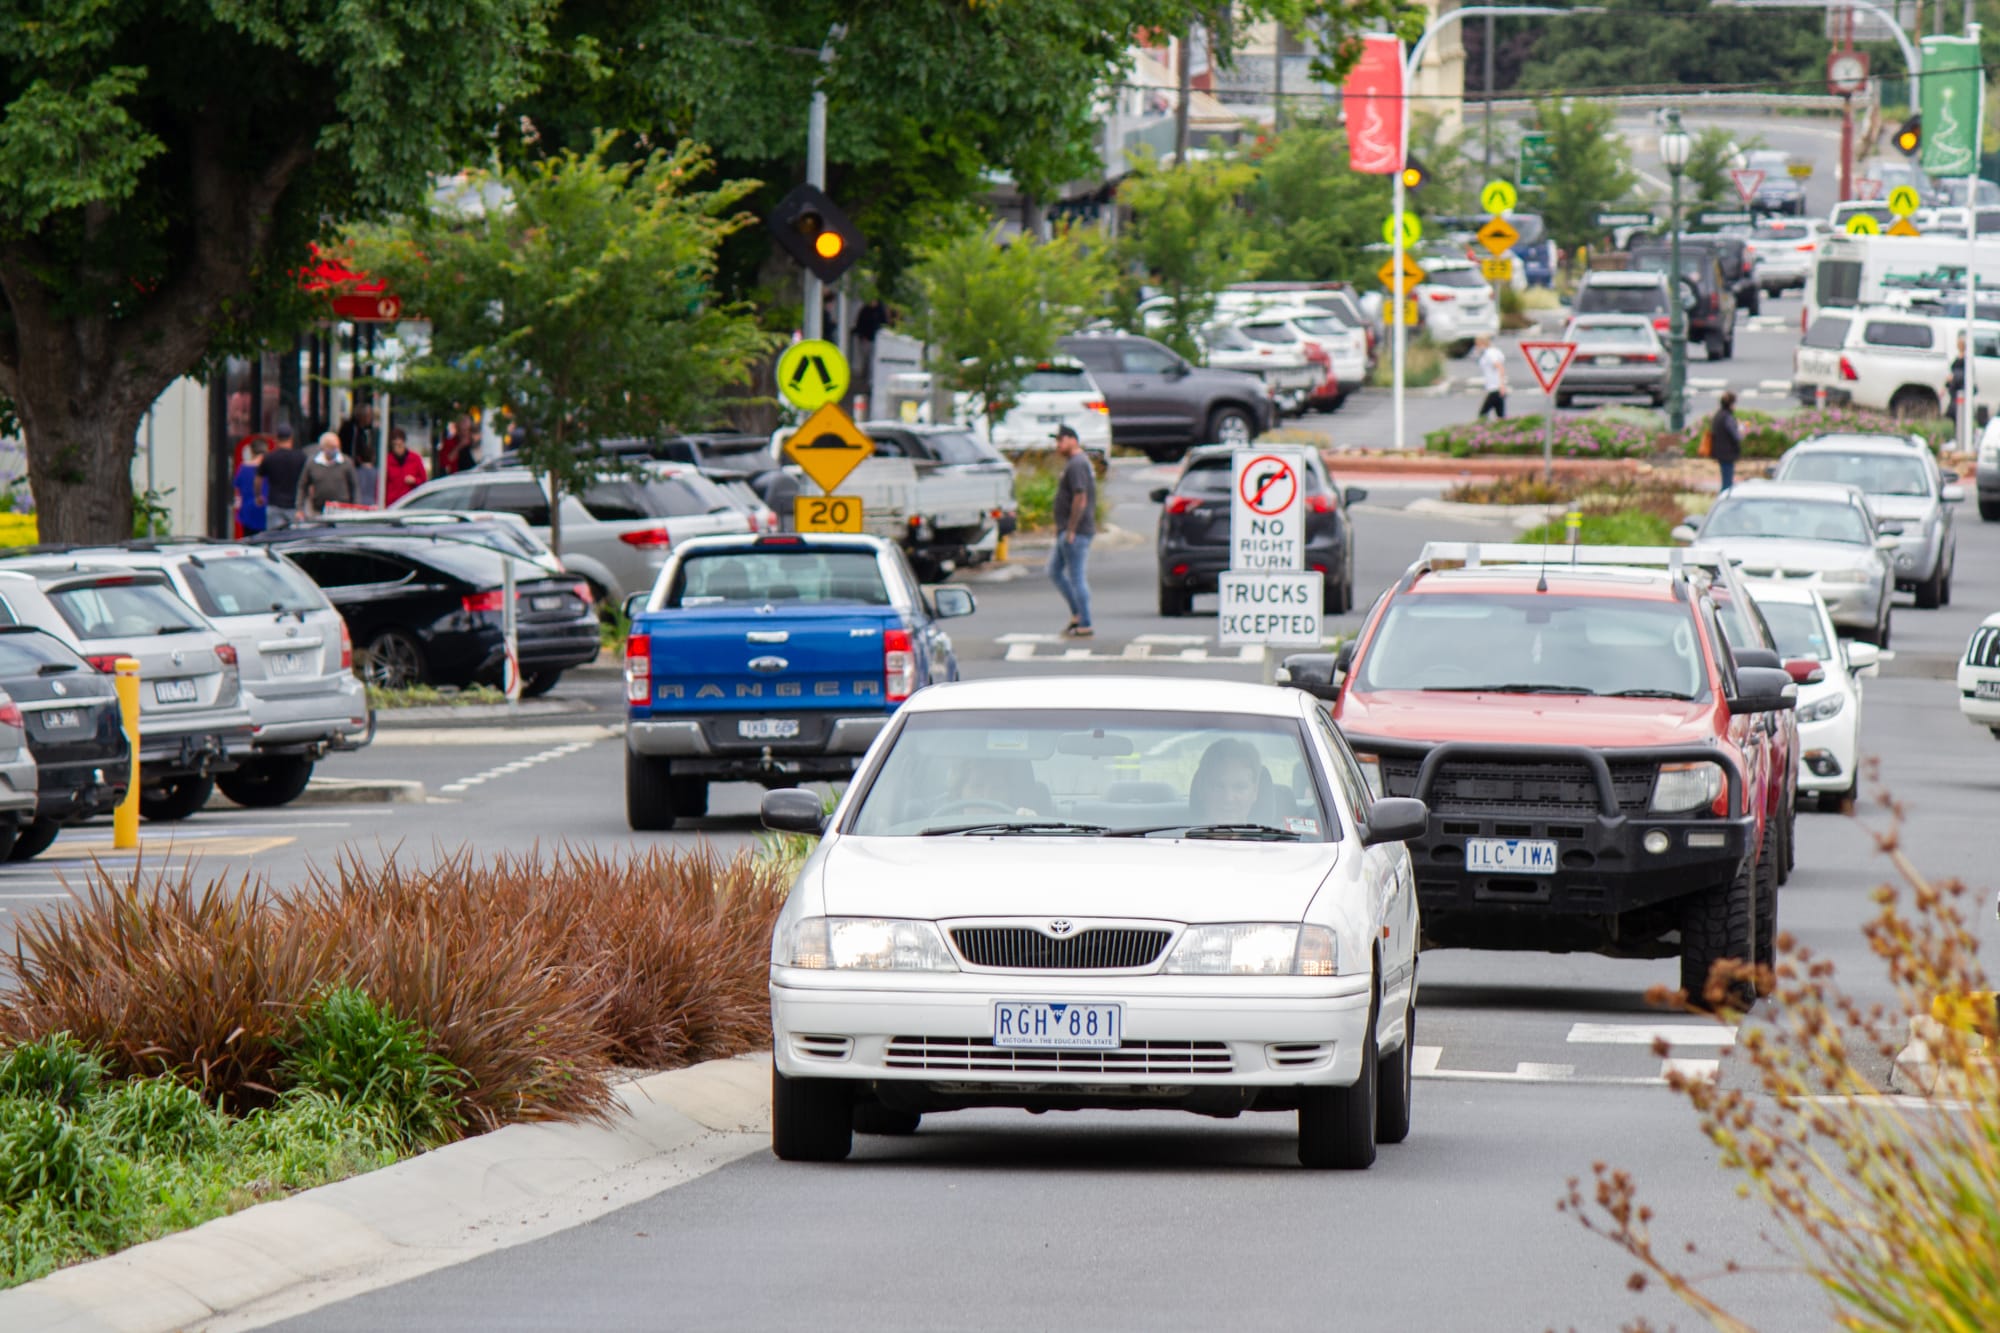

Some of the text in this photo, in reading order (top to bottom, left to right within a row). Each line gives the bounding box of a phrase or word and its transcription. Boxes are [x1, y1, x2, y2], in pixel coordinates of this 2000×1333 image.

[810, 501, 849, 525] 20
[1251, 519, 1284, 536] NO
[1240, 539, 1294, 552] RIGHT
[1244, 555, 1292, 568] TURN
[1226, 584, 1309, 604] TRUCKS
[658, 680, 879, 699] RANGER
[1000, 1008, 1113, 1037] RGH 881
